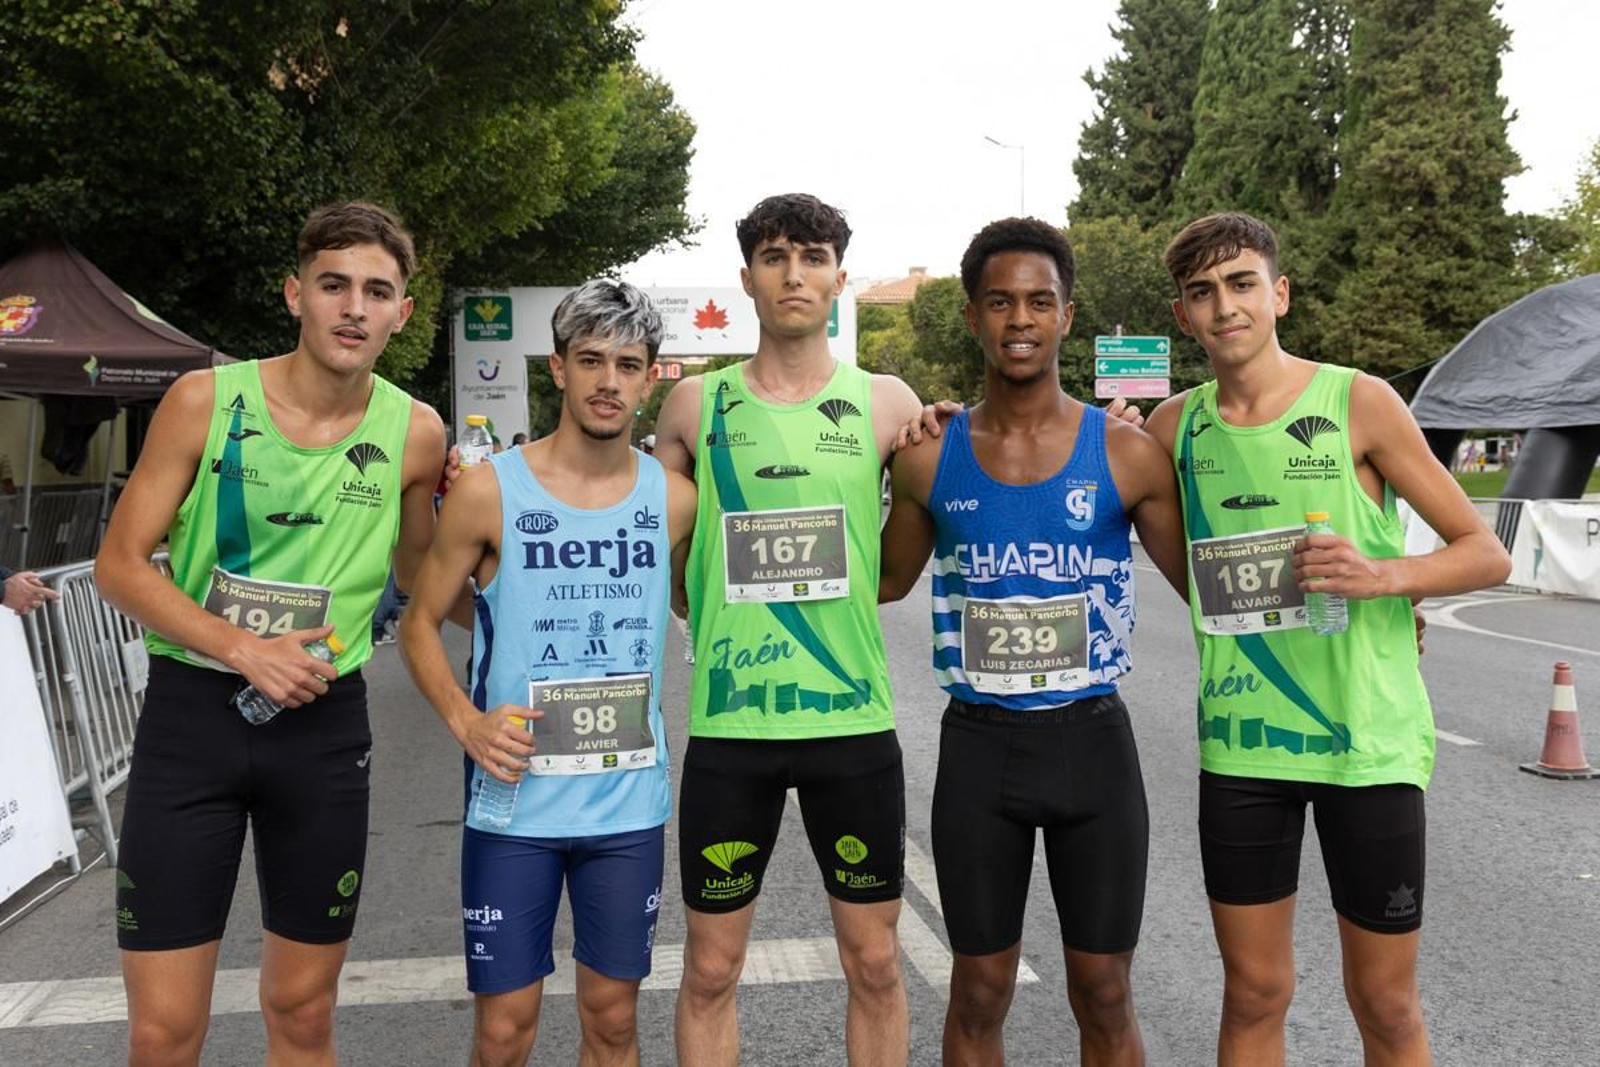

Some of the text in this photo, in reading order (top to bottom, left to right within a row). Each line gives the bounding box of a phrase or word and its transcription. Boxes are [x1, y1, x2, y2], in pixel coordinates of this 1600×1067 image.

[820, 432, 860, 447] Unicaja
[1288, 454, 1336, 470] Unicaja
[1283, 472, 1341, 481] Fundación Jaén
[342, 480, 382, 497] Unicaja
[944, 498, 980, 513] vive
[518, 514, 558, 531] TROPS
[733, 519, 751, 533] 36
[751, 521, 790, 532] Manuel
[791, 517, 838, 529] Pancorbo
[522, 528, 657, 579] nerja
[750, 534, 818, 565] 167
[1197, 547, 1214, 561] 36
[1214, 546, 1252, 559] Manuel
[955, 542, 1093, 577] CHAPIN
[751, 567, 823, 580] ALEJANDRO
[1217, 558, 1285, 594] 187
[216, 575, 228, 593] 36
[229, 587, 270, 602] Manuel
[272, 594, 322, 607] Pancorbo
[546, 583, 642, 601] ATLETISMO
[1231, 595, 1282, 610] ALVARO
[222, 603, 295, 637] 194
[970, 606, 989, 620] 36
[989, 610, 1028, 620] Manuel
[1030, 607, 1079, 620] Pancorbo
[987, 626, 1058, 656] 239
[712, 632, 798, 680] Jaén
[980, 656, 1071, 670] LUIS ZECARIAS
[1203, 664, 1263, 698] aén
[542, 688, 562, 703] 36
[564, 689, 601, 701] Manuel
[572, 704, 617, 736] 98
[575, 738, 618, 751] JAVIER
[705, 872, 753, 889] Unicaja
